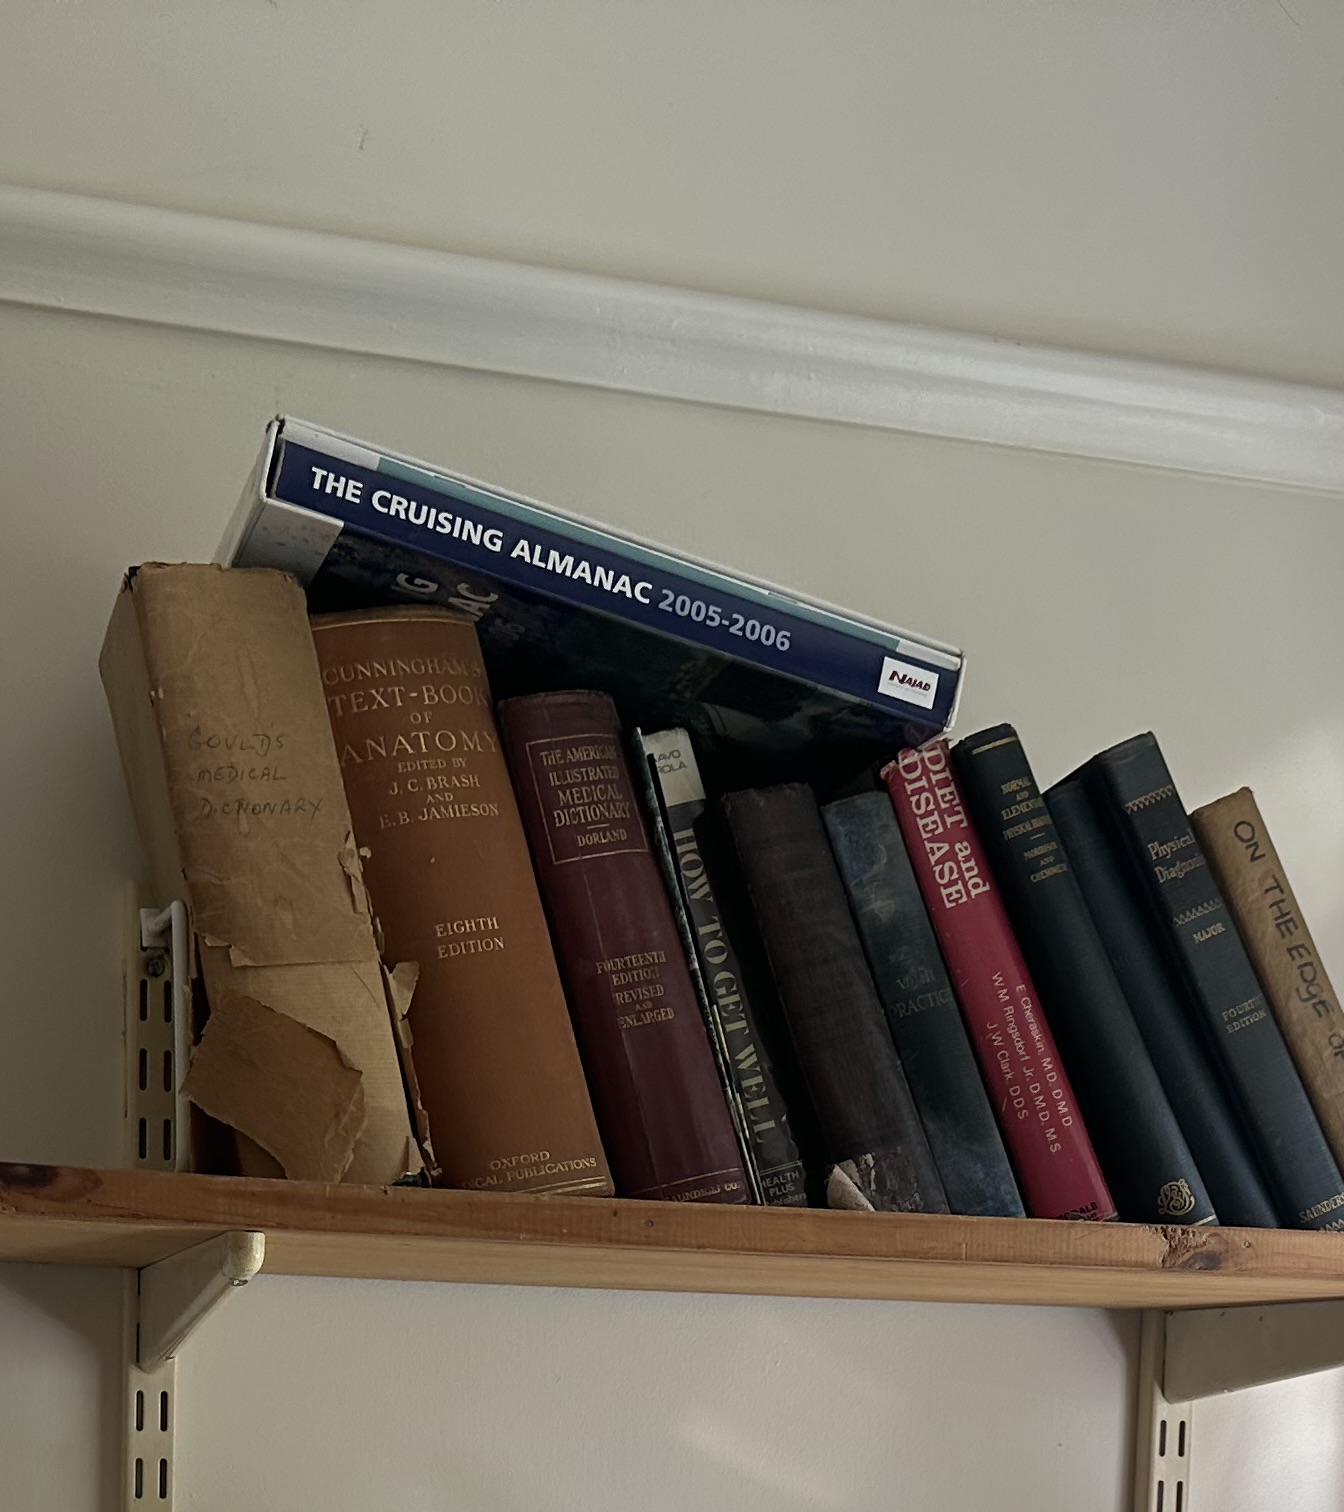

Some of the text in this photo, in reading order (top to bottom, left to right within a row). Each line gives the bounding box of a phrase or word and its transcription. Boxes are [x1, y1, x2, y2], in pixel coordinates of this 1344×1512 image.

[311, 466, 363, 503] THE
[371, 490, 504, 552] CRUISING
[510, 539, 653, 604] ALMANAC
[657, 588, 792, 651] 2005-2006
[328, 684, 490, 717] TEXT-BOOK
[410, 711, 433, 724] OF
[340, 730, 499, 766] ANATOMY
[540, 750, 563, 766] THE
[197, 763, 287, 784] MEDICAL
[398, 757, 468, 773] EDITED BY
[408, 778, 423, 792] C.
[427, 774, 481, 790] BRASH
[549, 766, 620, 787] ILLUSTRATED
[426, 792, 454, 805] AND
[558, 784, 623, 807] MEDICAL
[418, 803, 499, 821] JAMIESON
[553, 802, 631, 827] DICTIONARY
[922, 743, 991, 900] DIET and
[577, 828, 628, 847] DORLAND
[897, 751, 968, 909] DISEASE
[1147, 827, 1197, 860] Physical
[1233, 820, 1266, 863] ON
[1264, 873, 1299, 939] THE
[434, 916, 499, 938] EIGHTH
[1192, 922, 1226, 944] MAJOR
[437, 937, 505, 960] EDITION
[596, 951, 667, 975] FOURTEENTH
[615, 985, 665, 1005] REVISED
[673, 829, 777, 1143] HOW TO GET WELL
[617, 1007, 675, 1029] ENLARGED
[1226, 1010, 1267, 1034] EDITION
[489, 1150, 550, 1172] OXFORD
[507, 1157, 597, 1182] PUBLICATIONS
[769, 1183, 796, 1197] PLUS
